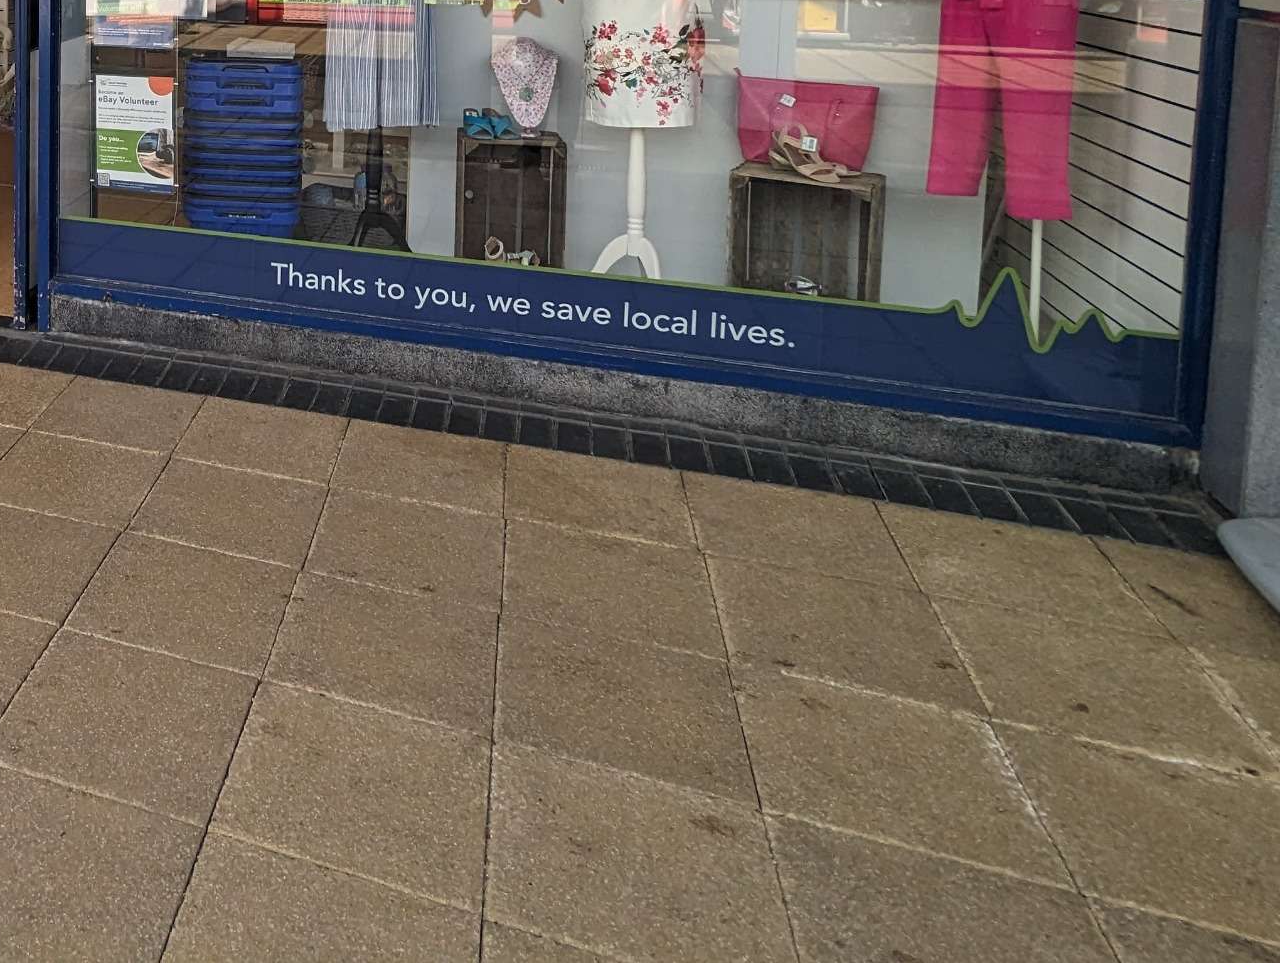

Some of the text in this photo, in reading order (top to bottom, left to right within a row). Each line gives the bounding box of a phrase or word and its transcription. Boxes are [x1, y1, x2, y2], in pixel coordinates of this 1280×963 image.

[98, 96, 159, 106] eBay Volunteer
[270, 262, 795, 348] Thanks to you, we save local lives.
